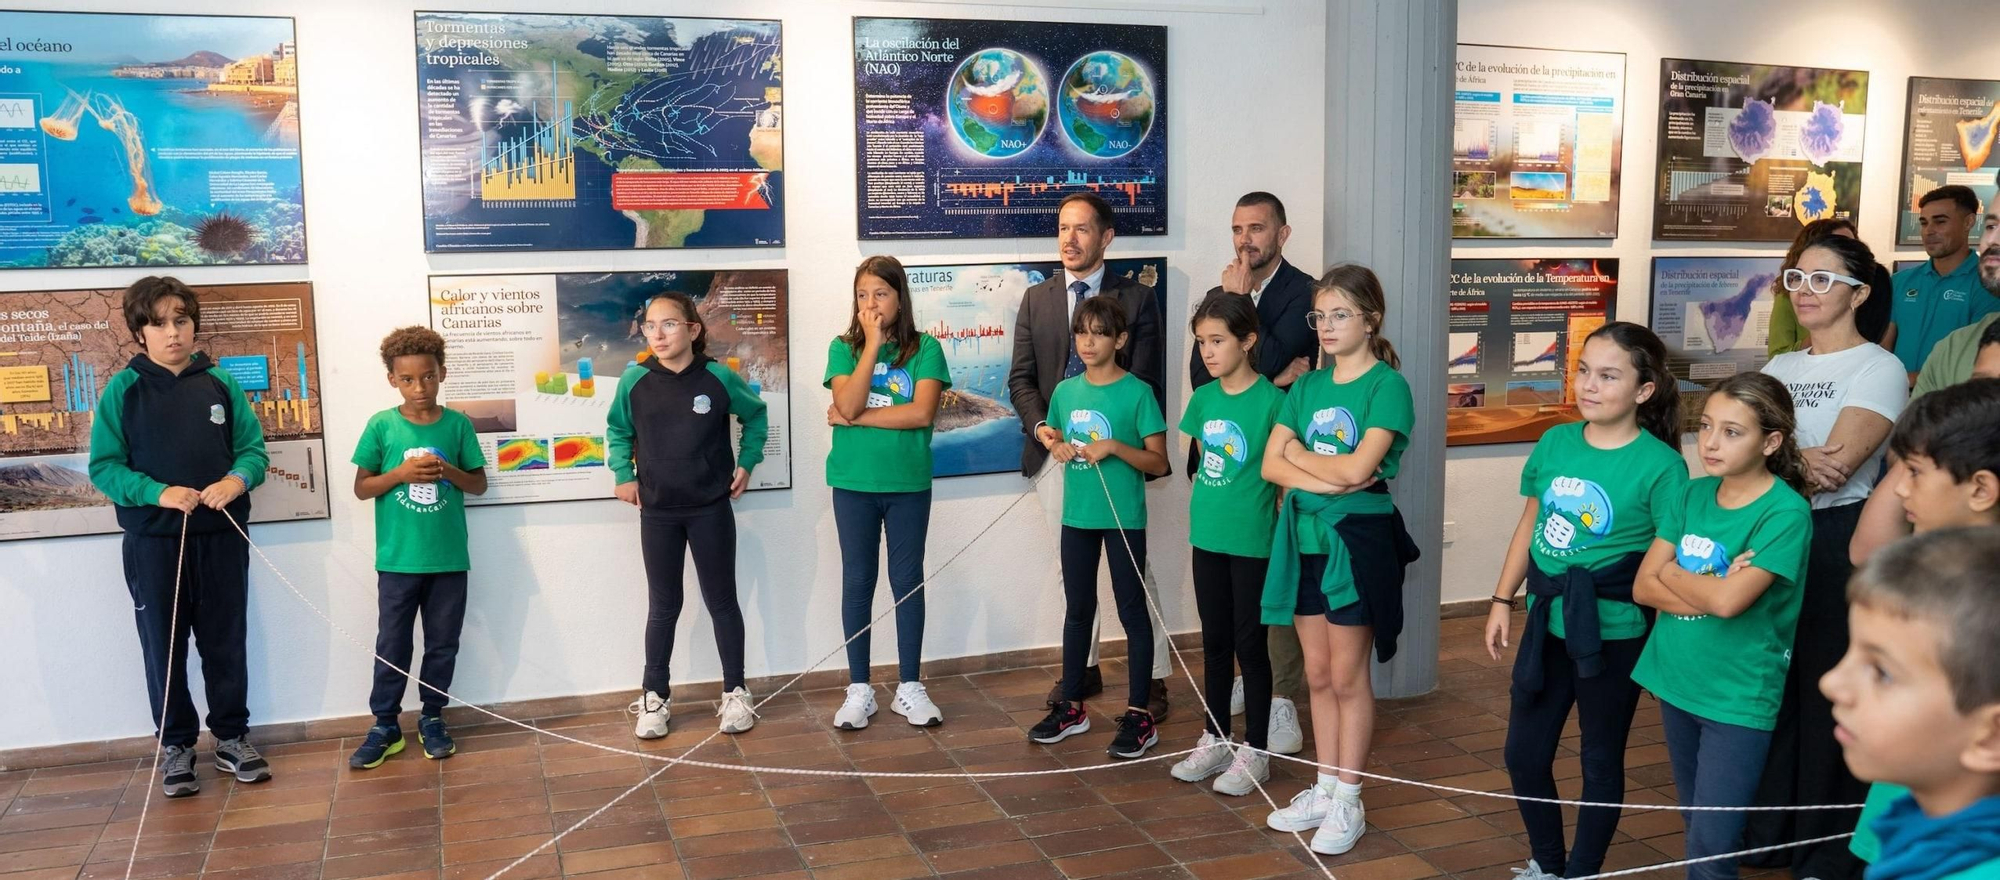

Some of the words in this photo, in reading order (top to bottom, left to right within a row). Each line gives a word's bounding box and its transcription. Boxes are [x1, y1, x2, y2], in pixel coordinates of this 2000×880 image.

[425, 21, 505, 34] Tormentas
[16, 38, 72, 52] océano
[425, 38, 435, 50] y
[438, 35, 528, 51] depresiones
[865, 37, 880, 48] La
[882, 37, 940, 49] oscilación
[942, 38, 960, 50] del
[426, 52, 500, 68] tropicales
[865, 49, 918, 62] Atlántico
[921, 51, 954, 62] Norte
[866, 62, 900, 76] (NAO)
[1466, 62, 1476, 72] de
[1478, 62, 1486, 73] la
[1488, 64, 1528, 74] evolución
[1530, 66, 1540, 75] de
[1542, 66, 1550, 76] la
[1552, 67, 1604, 79] precipitación
[1468, 75, 1486, 84] África
[1670, 71, 1718, 84] Distribución
[1720, 75, 1750, 86] espacial
[1684, 84, 1722, 92] precipitación
[1685, 90, 1706, 98] Canaria
[1918, 94, 1959, 106] Distribución
[1960, 96, 1986, 108] espacial
[1958, 107, 1983, 116] Tenerife
[1001, 140, 1026, 148] NAO+
[1461, 274, 1472, 283] de
[1474, 273, 1481, 283] la
[1483, 273, 1523, 284] evolución
[1525, 273, 1535, 283] de
[1536, 273, 1544, 283] la
[1546, 274, 1598, 285] Temperatura
[1661, 270, 1708, 280] Distribución
[1710, 270, 1739, 281] espacial
[1674, 281, 1710, 289] precipitación
[441, 289, 477, 302] Calor
[480, 292, 488, 304] y
[492, 288, 540, 300] vientos
[1458, 288, 1467, 296] de
[1467, 287, 1485, 296] África
[441, 303, 504, 315] africanos
[506, 302, 544, 314] sobre
[11, 310, 50, 320] secos
[0, 320, 56, 332] ontaña,
[58, 322, 68, 331] el
[70, 322, 92, 330] caso
[94, 320, 109, 330] del
[442, 316, 502, 329] Canarias
[0, 334, 16, 342] del
[18, 333, 46, 342] Teide
[48, 332, 82, 342] (Izaña)
[1813, 390, 1837, 399] ONE
